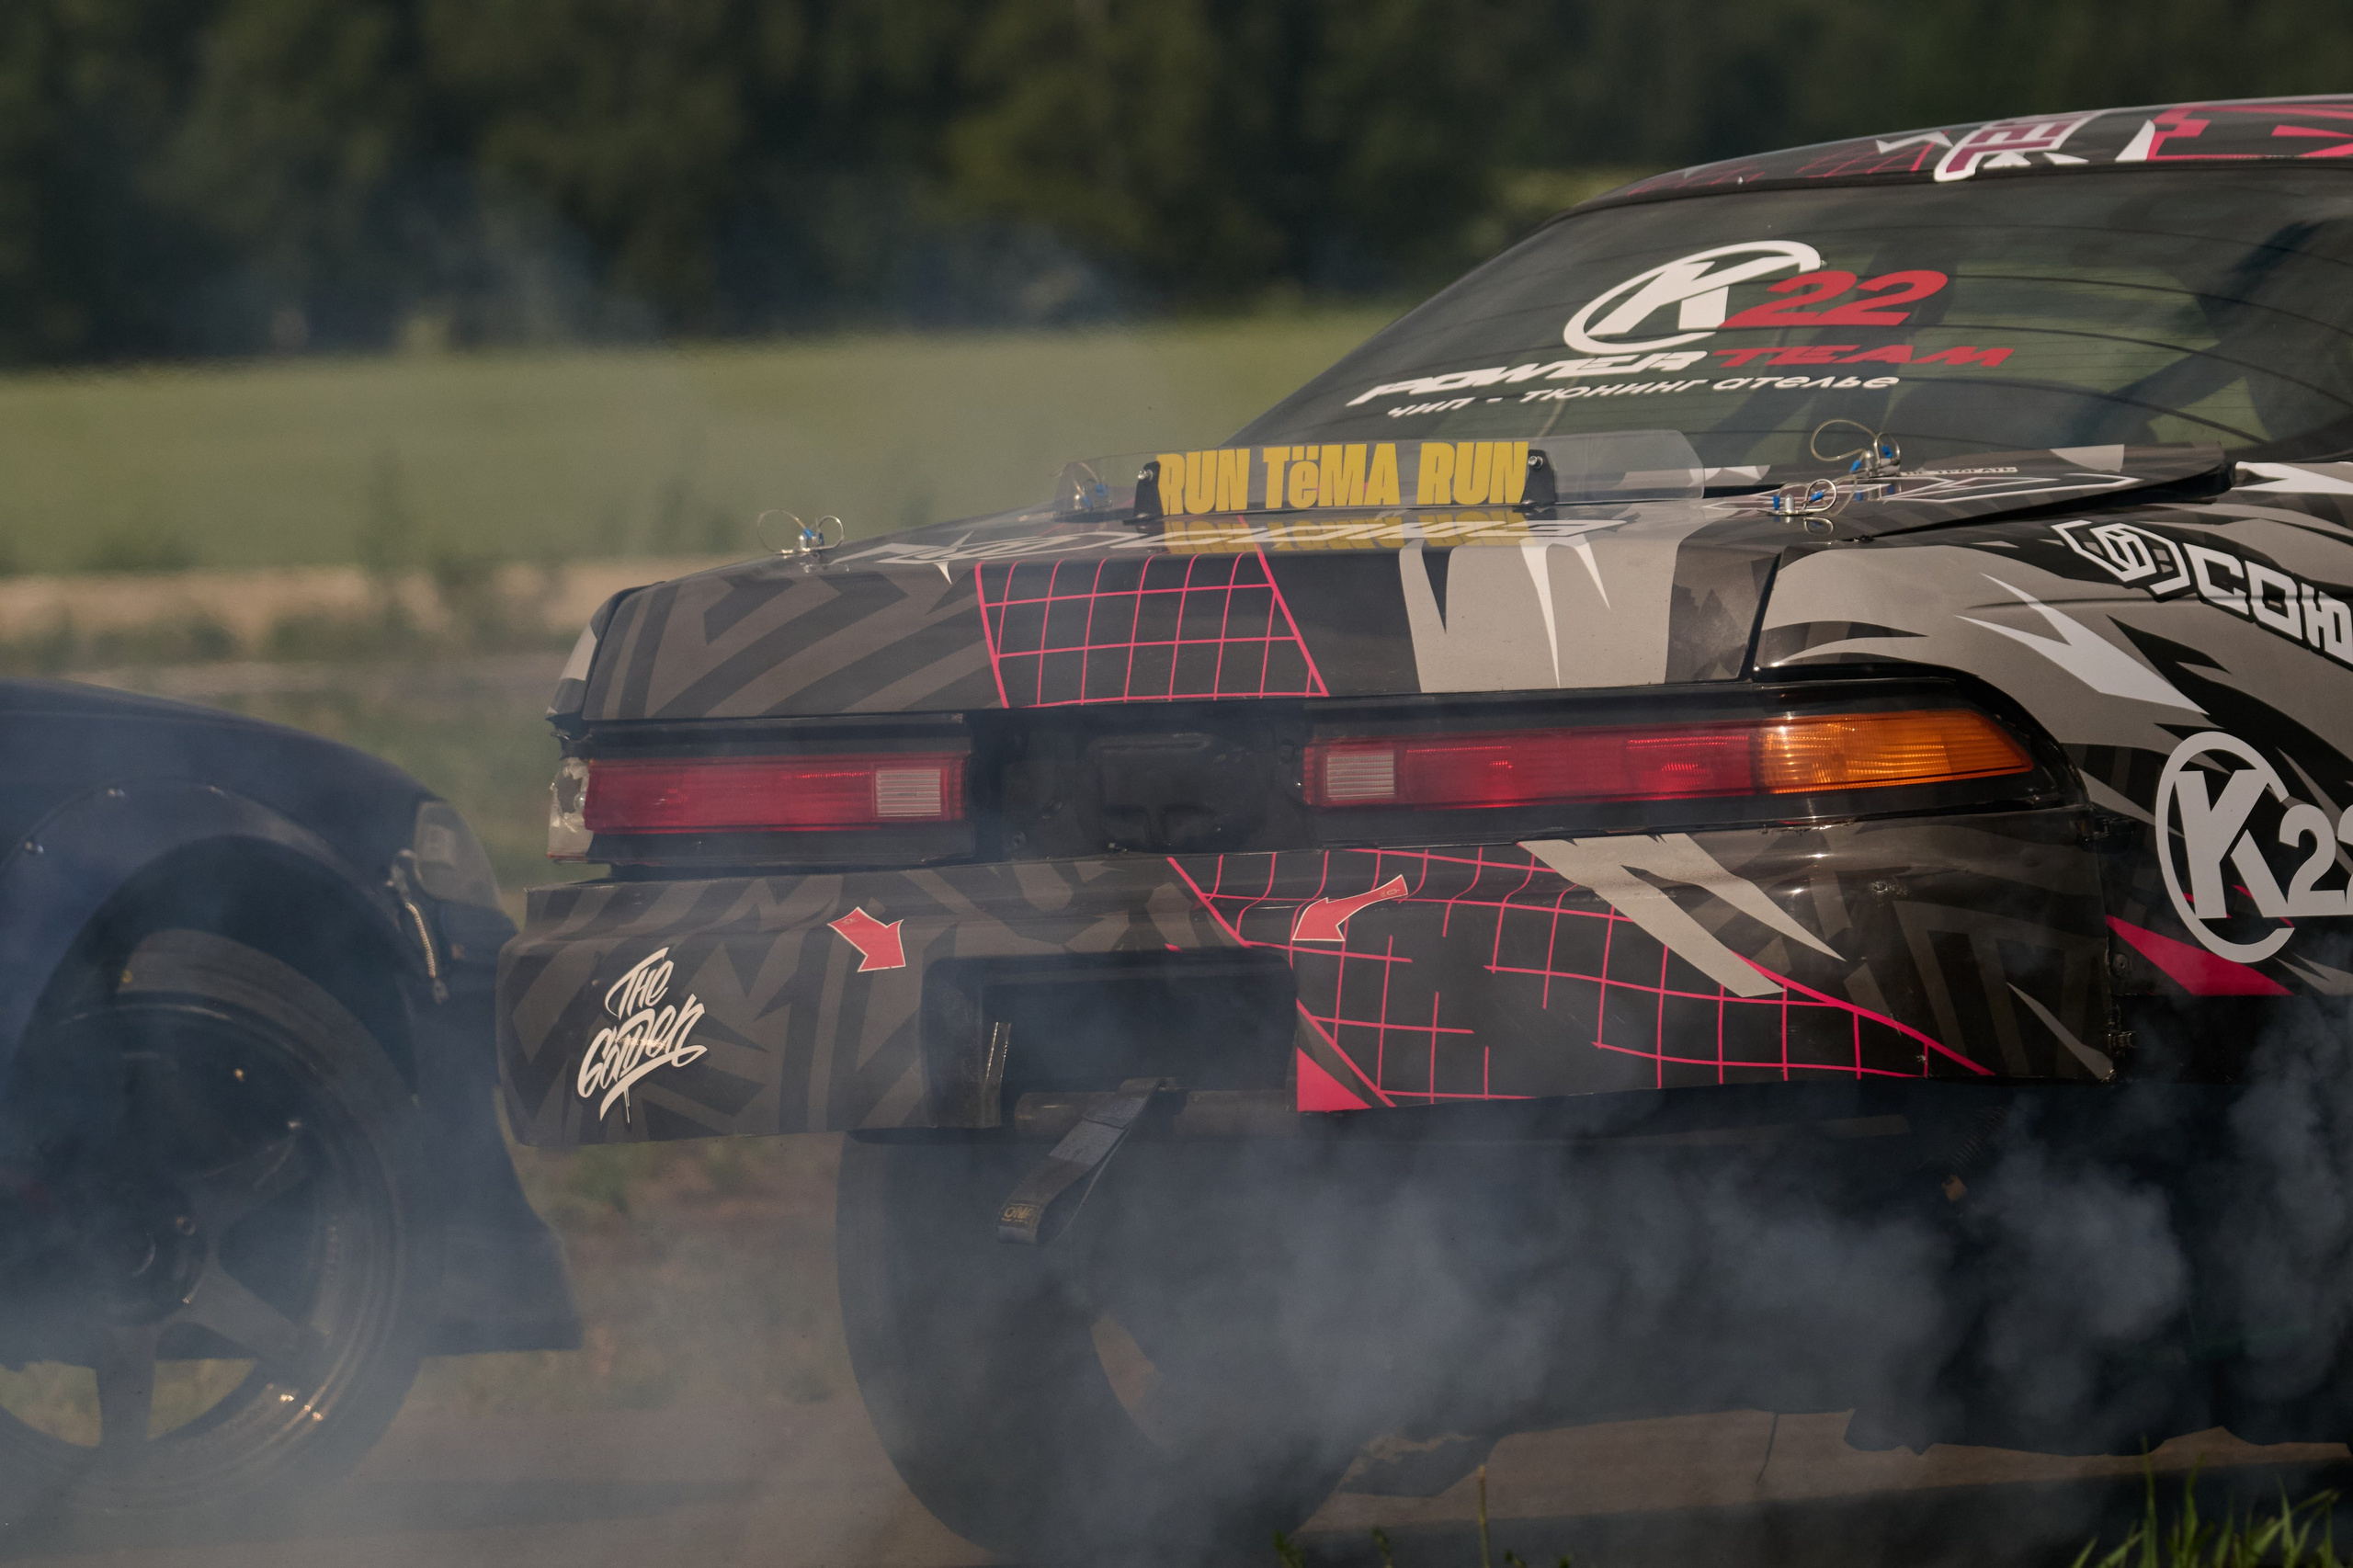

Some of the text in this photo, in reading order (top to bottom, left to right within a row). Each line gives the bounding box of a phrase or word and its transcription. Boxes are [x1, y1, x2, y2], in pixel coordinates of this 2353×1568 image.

[1572, 247, 1948, 344] K22
[1346, 344, 2015, 406] POWER TEAM
[1156, 448, 1250, 516] RUN
[1416, 440, 1529, 506] RUN
[2162, 752, 2353, 937] K2
